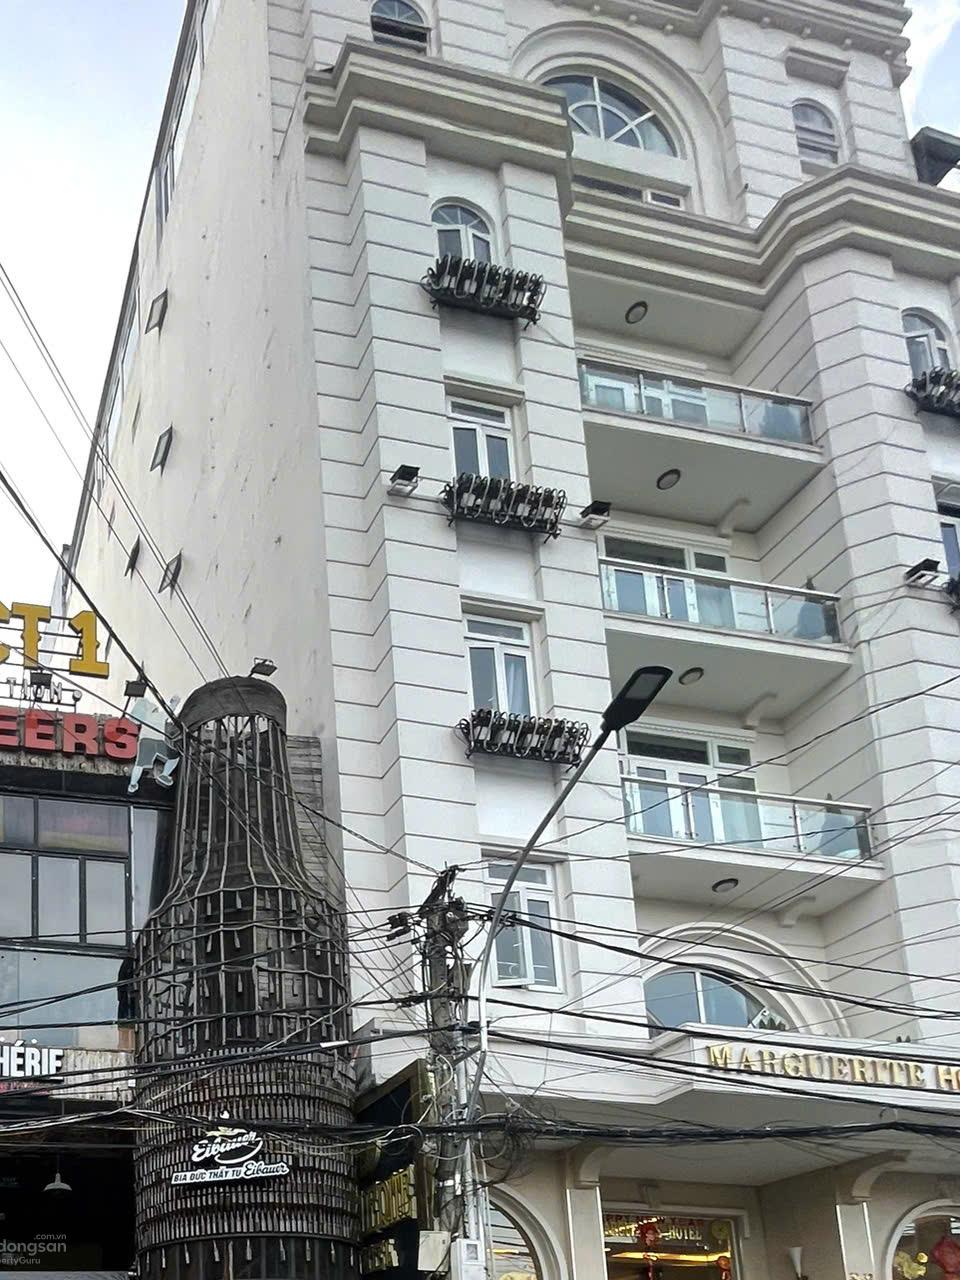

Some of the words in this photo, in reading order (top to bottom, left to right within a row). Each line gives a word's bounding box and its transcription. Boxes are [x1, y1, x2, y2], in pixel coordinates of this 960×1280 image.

[69, 609, 110, 678] 1
[706, 1044, 926, 1088] MARGUERITE
[936, 1064, 960, 1092] H
[174, 1172, 188, 1183] BIA
[244, 1161, 288, 1178] Eibauer
